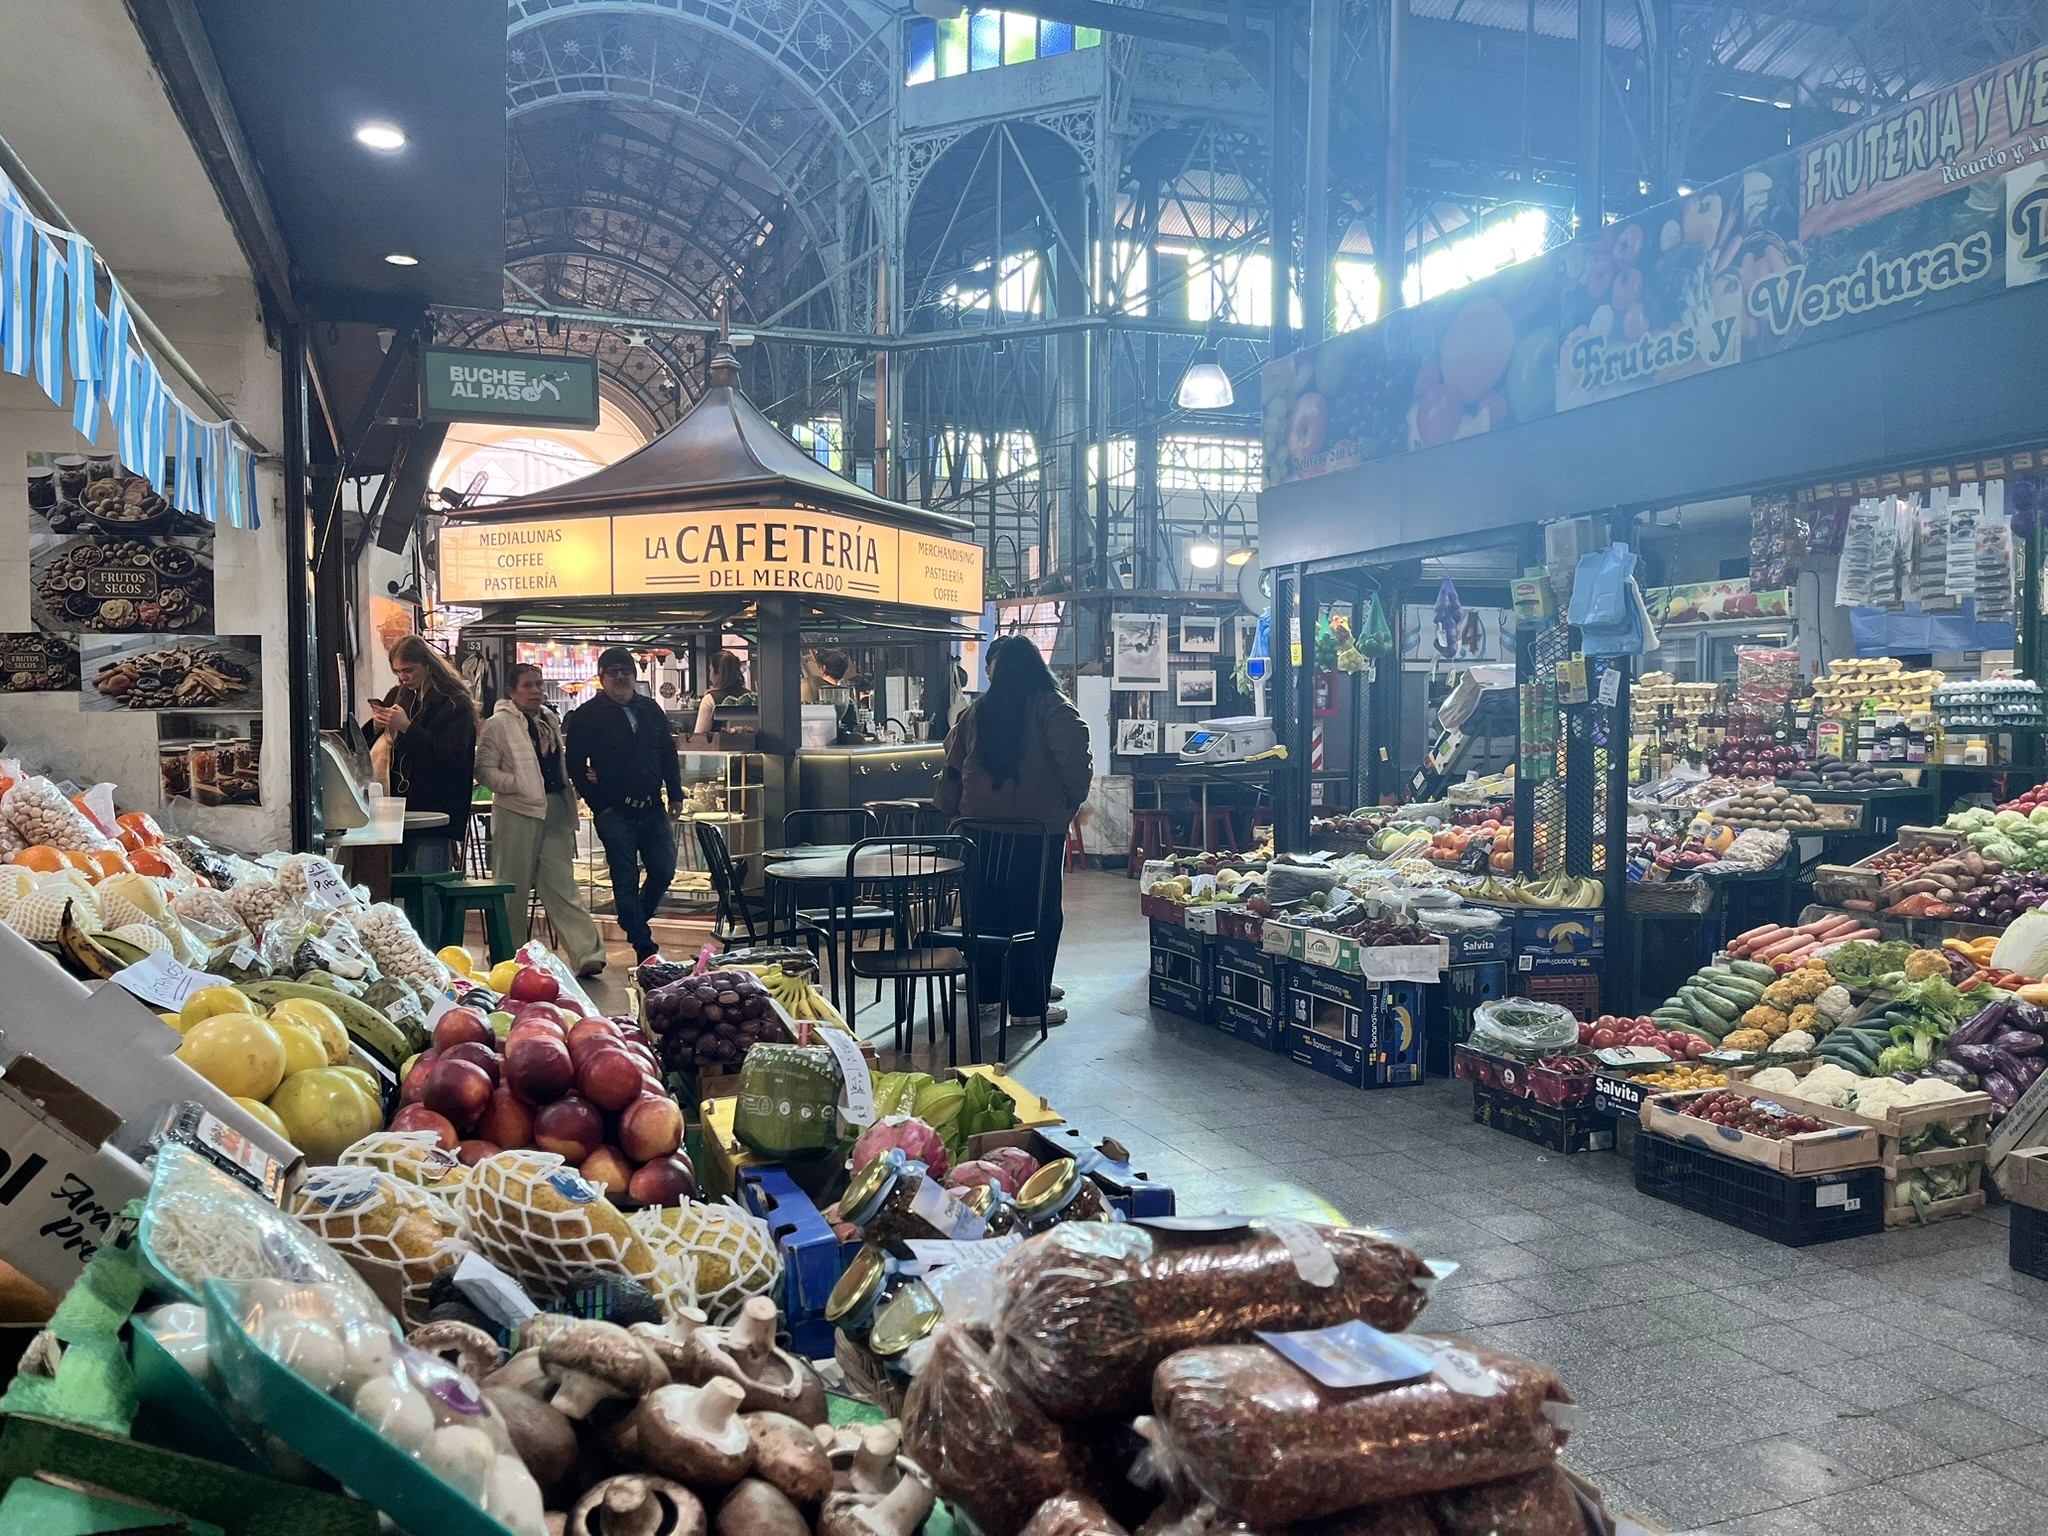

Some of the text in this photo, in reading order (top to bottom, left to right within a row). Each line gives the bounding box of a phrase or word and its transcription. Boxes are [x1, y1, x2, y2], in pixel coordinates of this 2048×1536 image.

[1804, 87, 1965, 213] FRUTERIA
[1972, 69, 1998, 152] Y
[1939, 145, 2007, 185] Ricardo
[2008, 143, 2025, 165] y
[1748, 232, 1991, 334] Verduras
[1570, 314, 1737, 391] Frutas y
[450, 365, 526, 386] BUCHE
[451, 382, 479, 398] AL
[1330, 446, 1345, 462] Sin
[479, 528, 562, 546] MEDIALUNAS
[645, 523, 880, 575] LA CAFETERÍA
[918, 541, 975, 565] MERCHANDISING
[497, 553, 544, 568] COFFEE
[100, 572, 146, 584] FRUTOS
[485, 572, 558, 591] PASTELERÍA
[710, 569, 843, 592] DEL MERCADO
[925, 566, 964, 584] PASTELERÍA
[104, 583, 141, 594] SECOS
[933, 587, 959, 602] COFFEE
[11, 655, 40, 663] FRUTOS
[14, 661, 37, 669] SECOS
[1463, 940, 1494, 951] Salvita
[1595, 1077, 1639, 1103] Salvita
